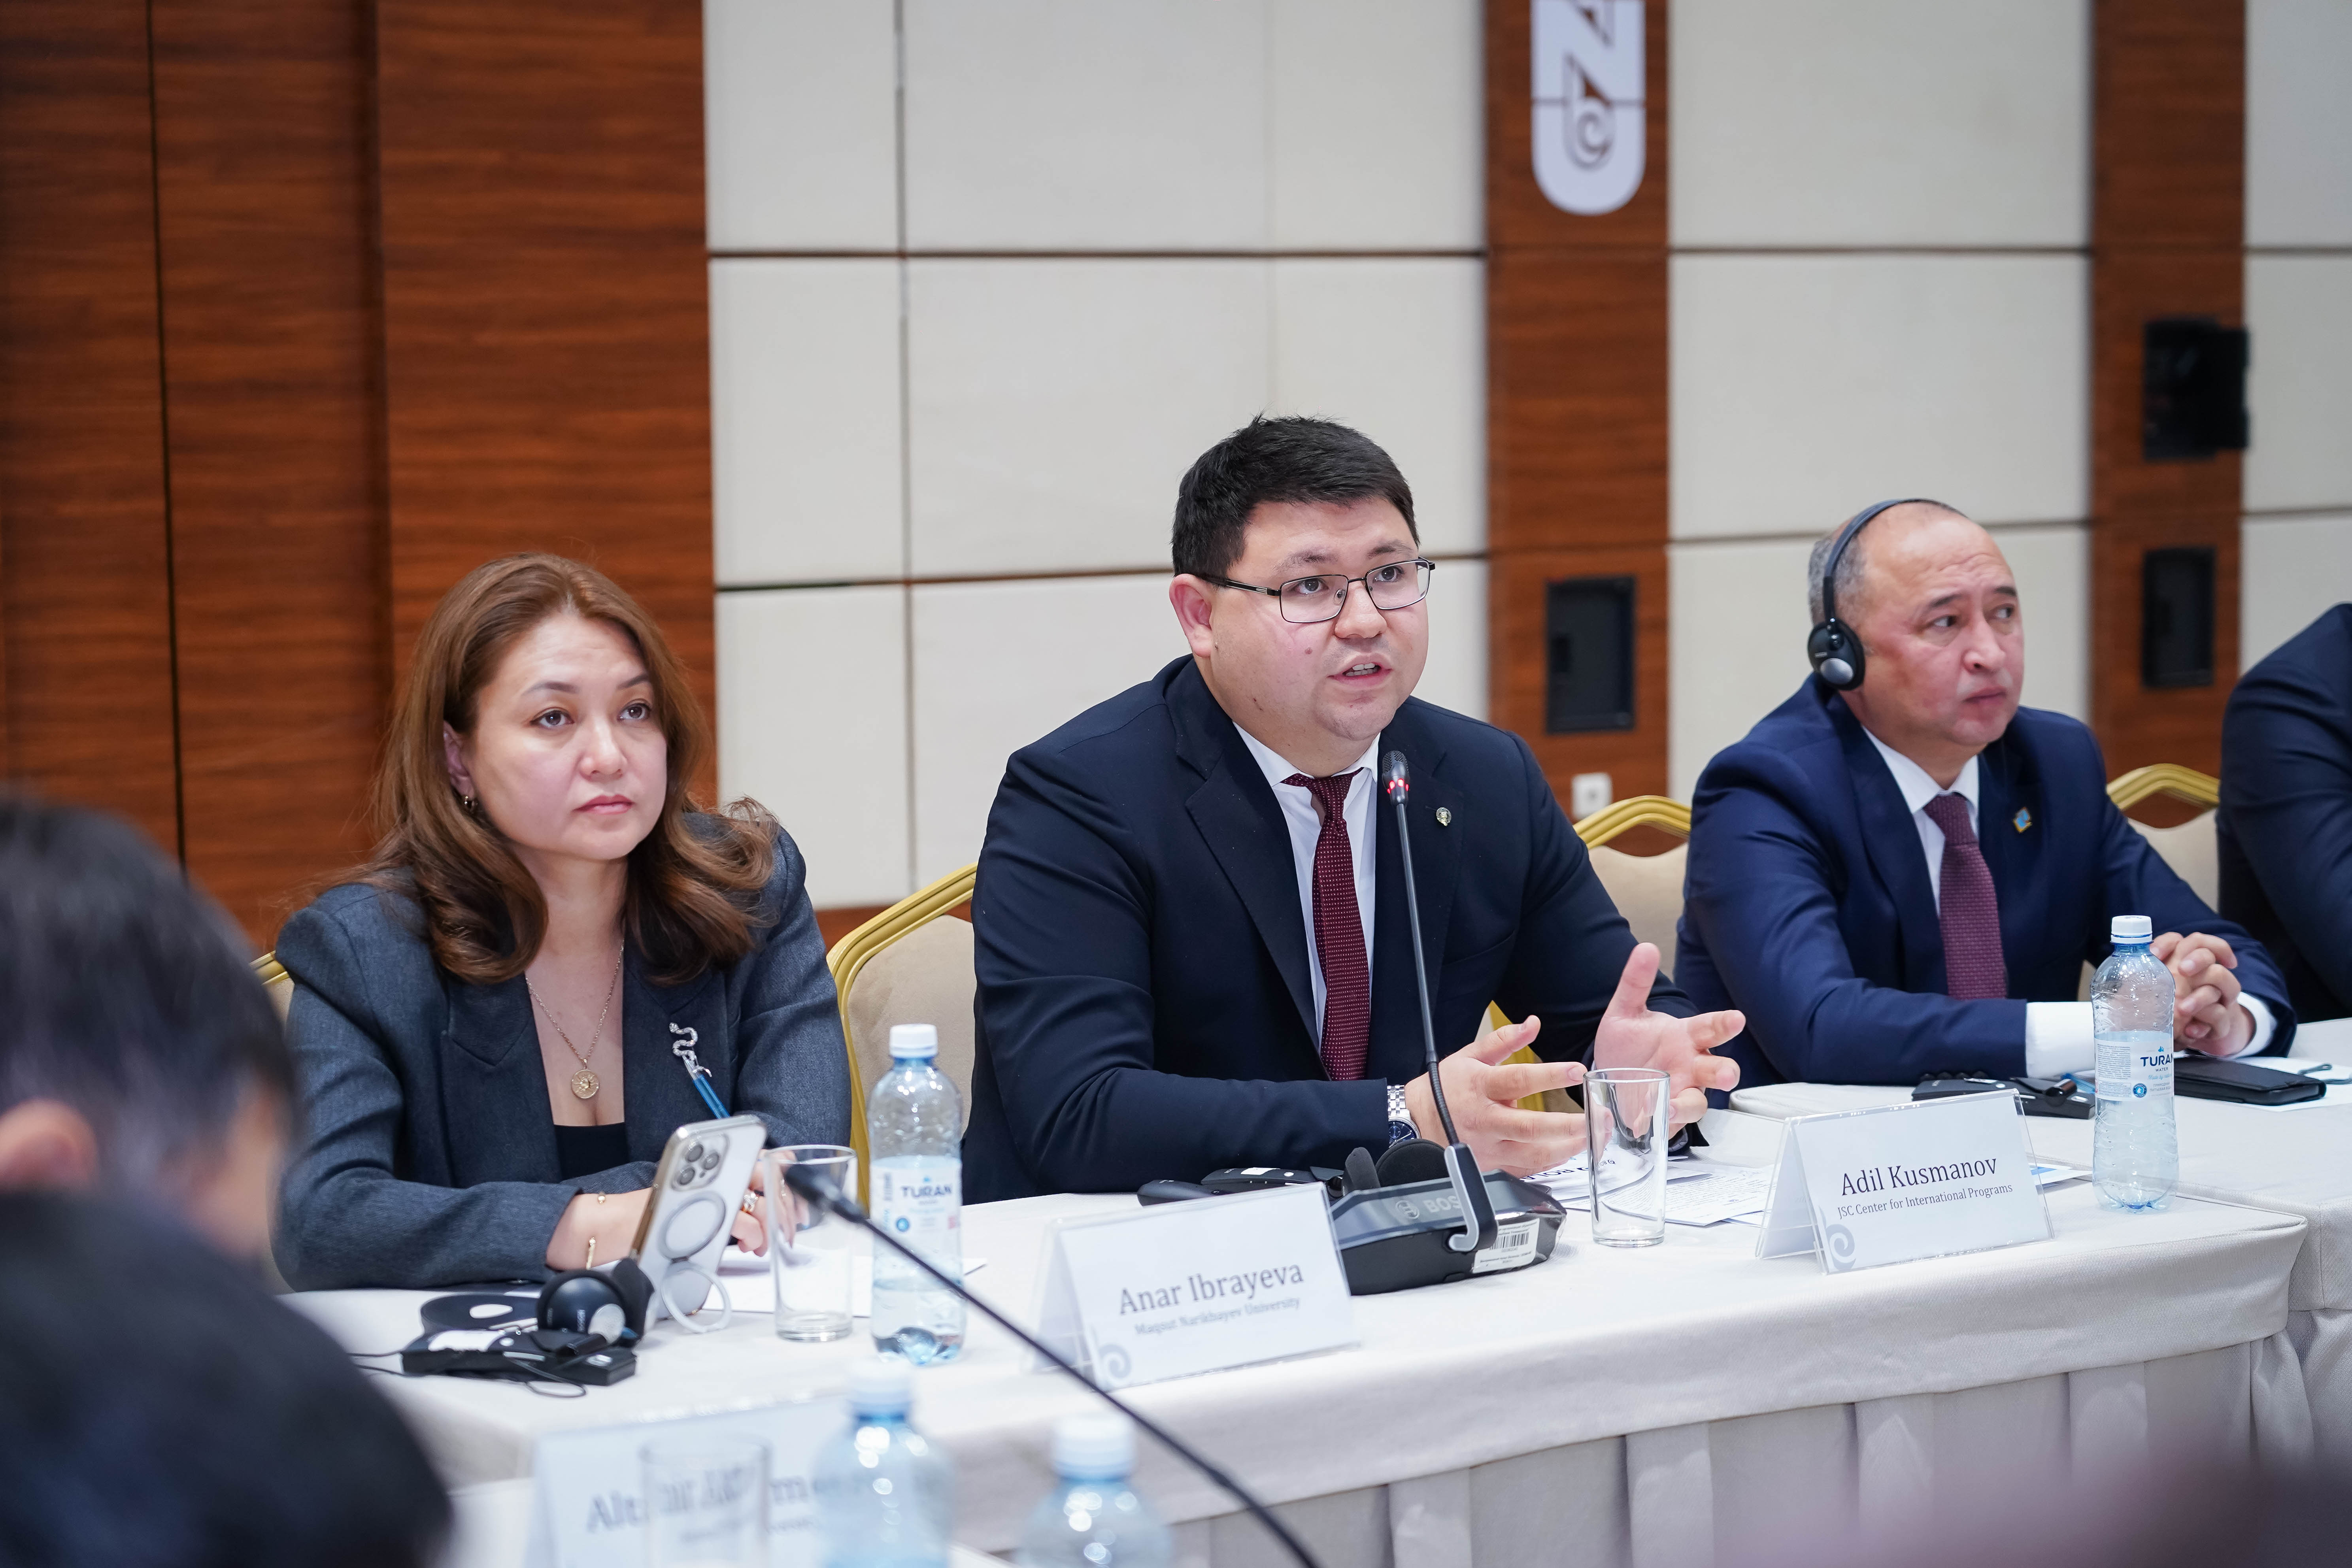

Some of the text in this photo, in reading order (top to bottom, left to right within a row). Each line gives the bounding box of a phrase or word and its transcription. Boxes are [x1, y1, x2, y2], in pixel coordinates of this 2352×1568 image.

[1521, 1169, 1575, 1181] BOLA
[1842, 1158, 1997, 1196] Adil Kusmanov
[900, 1184, 952, 1198] TURAN
[1423, 1195, 1462, 1213] BOS
[1837, 1184, 2013, 1219] JSC Center for International Programs
[1119, 1264, 1304, 1315] Anar Ibrayeva
[1244, 1297, 1300, 1315] University
